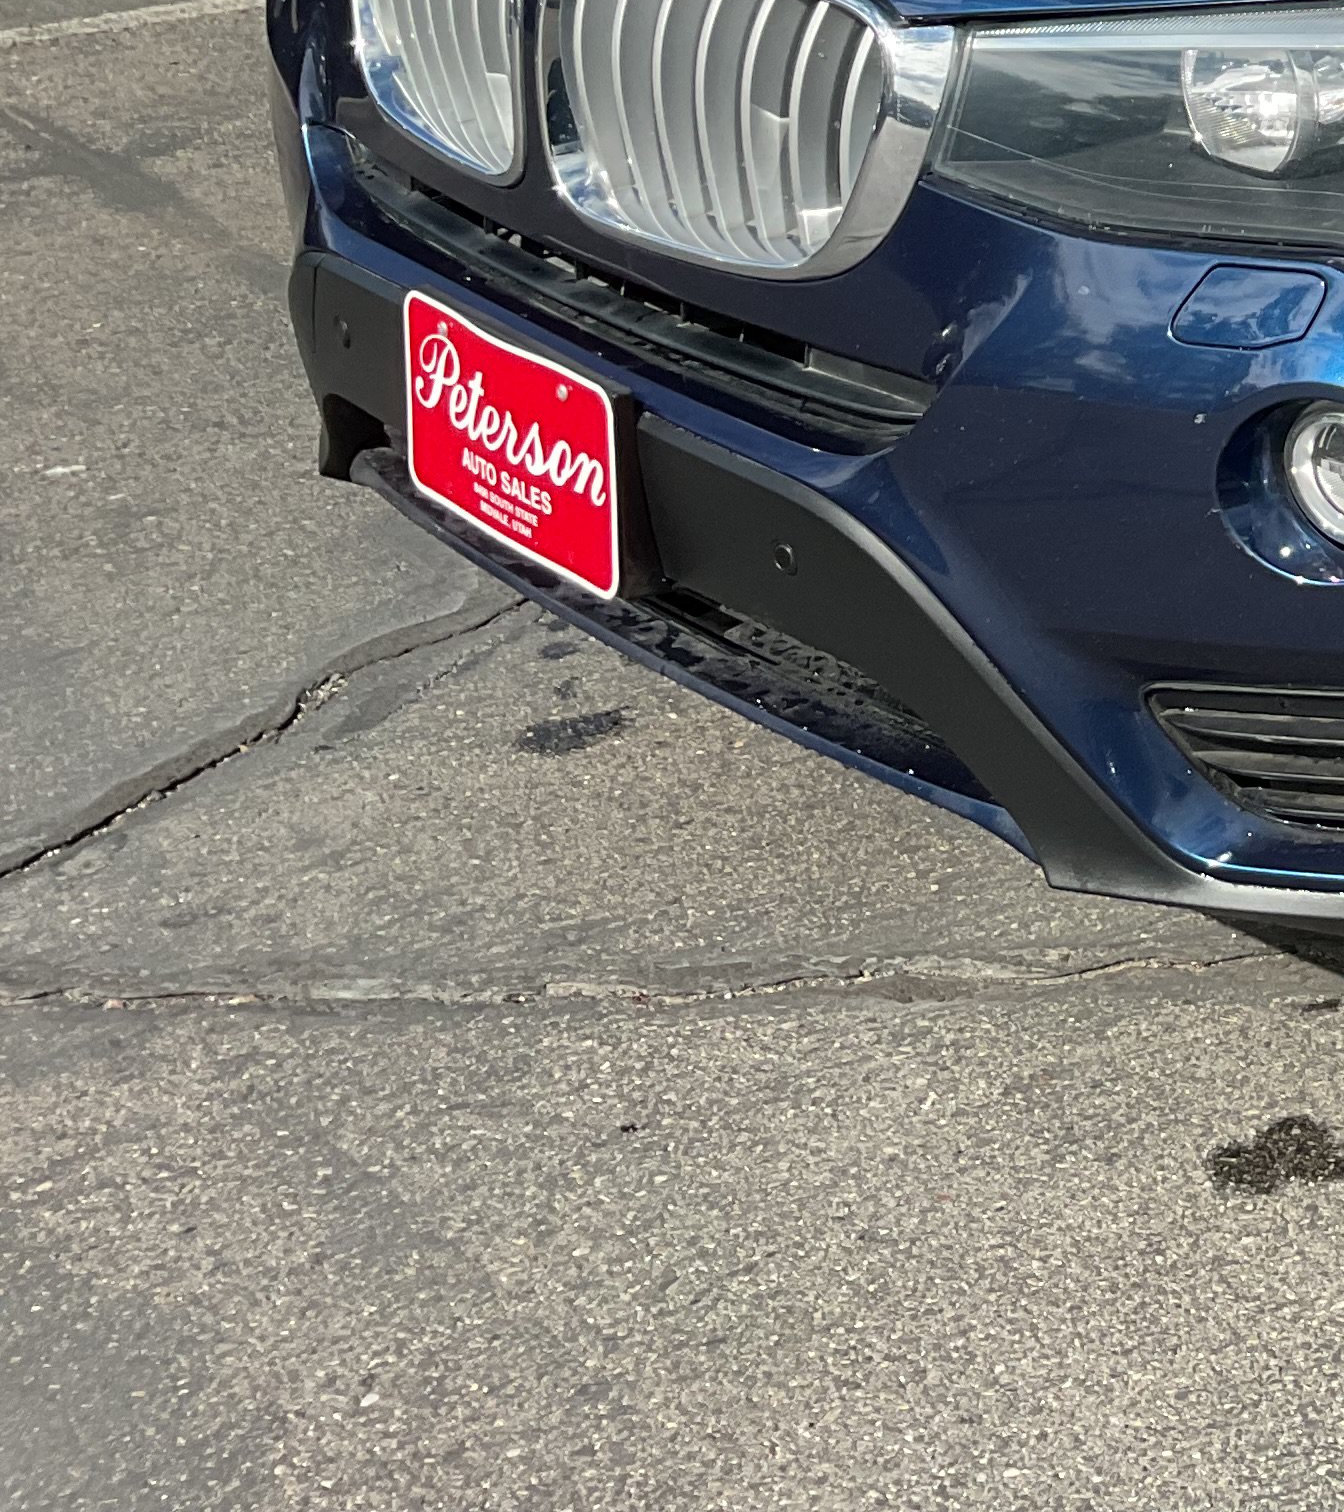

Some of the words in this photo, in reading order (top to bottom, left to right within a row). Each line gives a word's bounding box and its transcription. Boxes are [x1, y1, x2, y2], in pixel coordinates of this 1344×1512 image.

[415, 333, 606, 507] Peterson
[462, 447, 497, 486] AUTO
[501, 471, 553, 515] SALES
